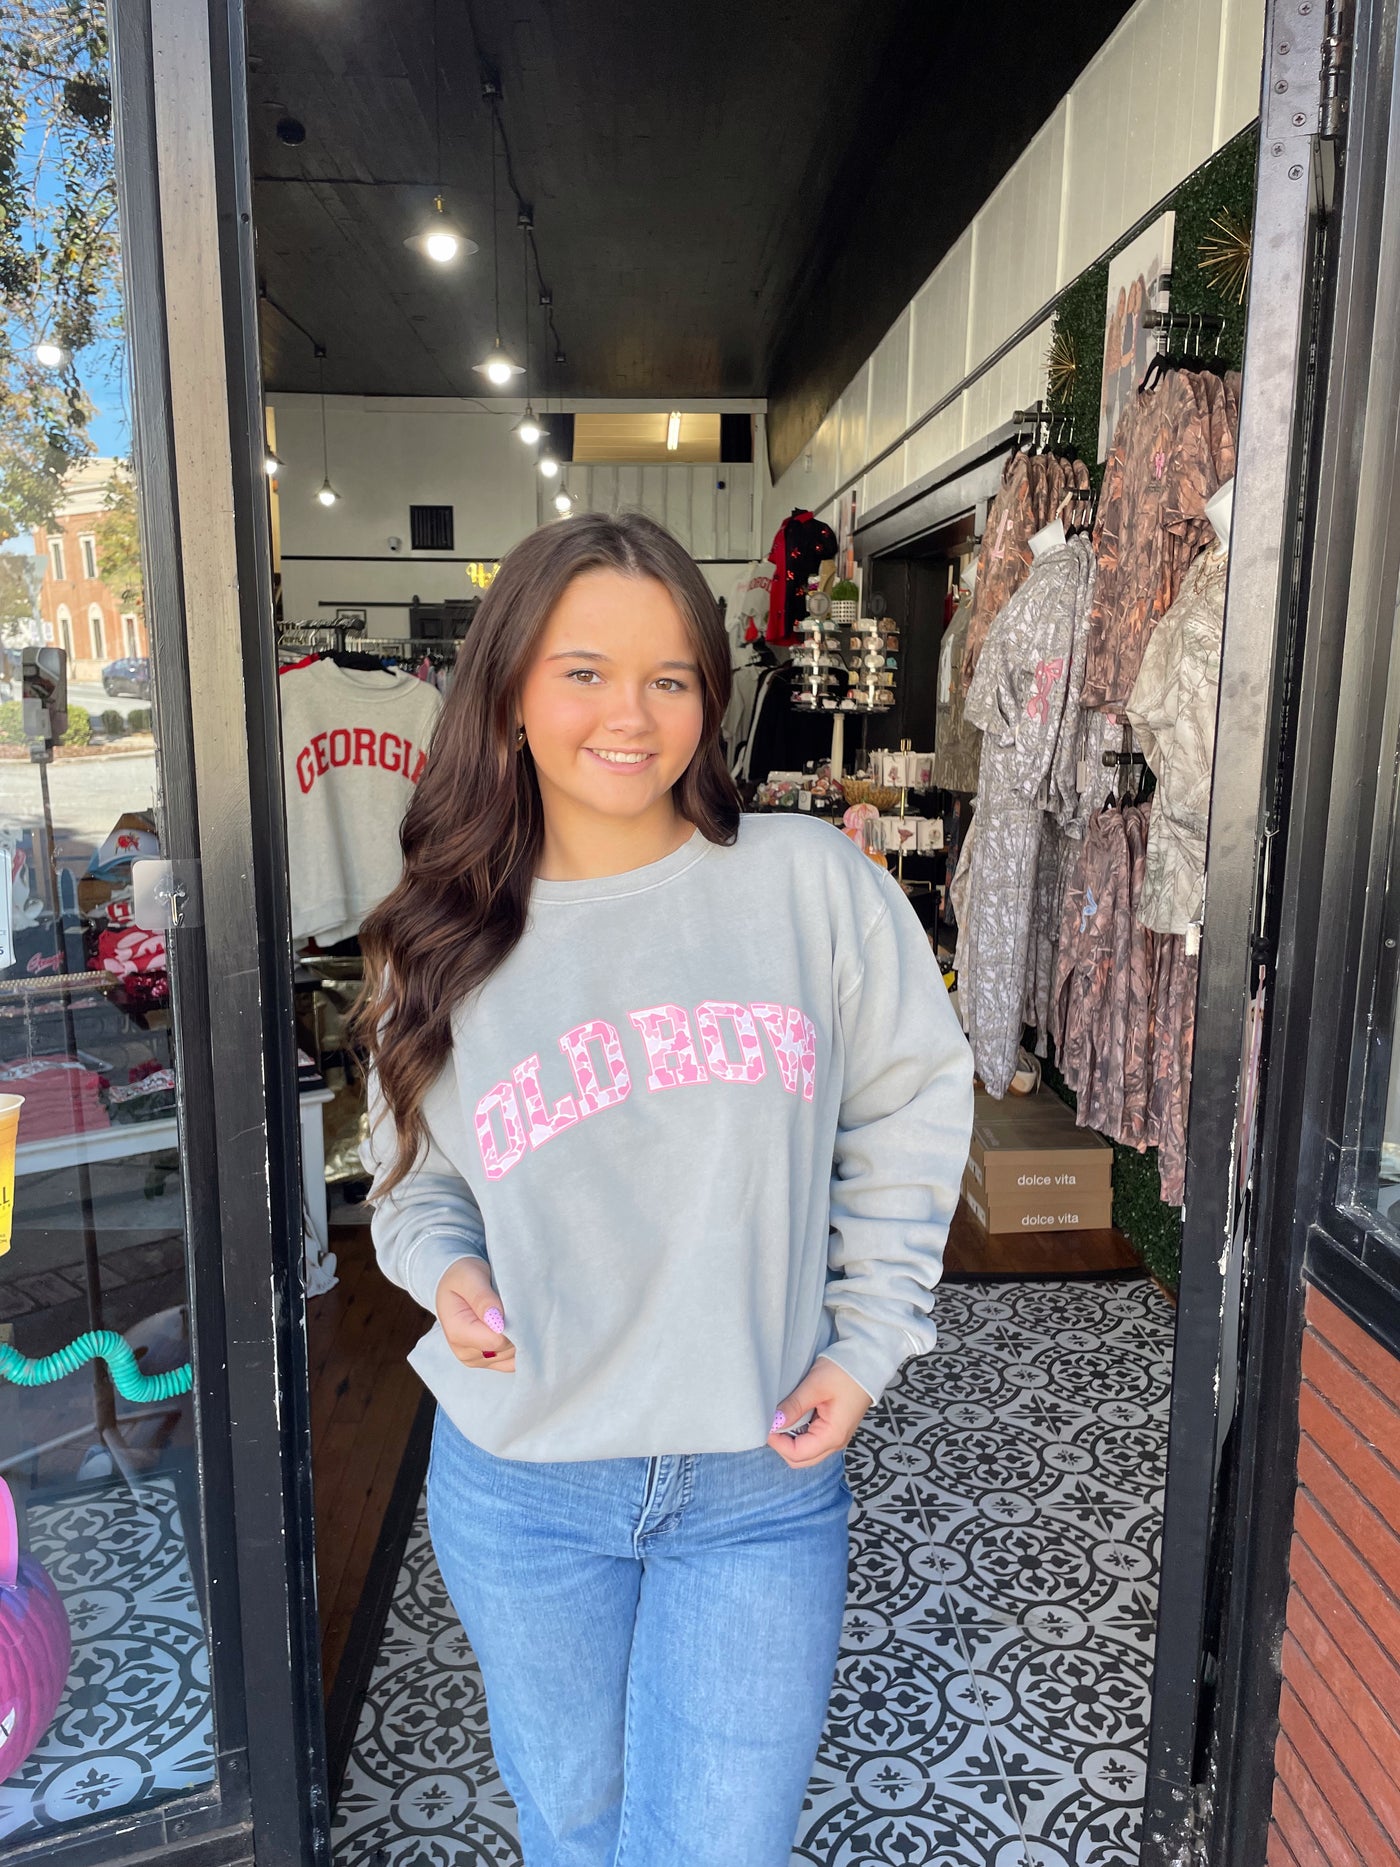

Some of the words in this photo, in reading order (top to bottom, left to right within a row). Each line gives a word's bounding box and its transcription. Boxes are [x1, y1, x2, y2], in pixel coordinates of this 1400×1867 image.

[474, 1020, 632, 1181] OLD
[627, 1000, 817, 1103] ROW
[1017, 1174, 1051, 1186] dolce
[1055, 1173, 1076, 1185] vita
[1021, 1213, 1054, 1226] dolce
[1058, 1212, 1079, 1224] vita
